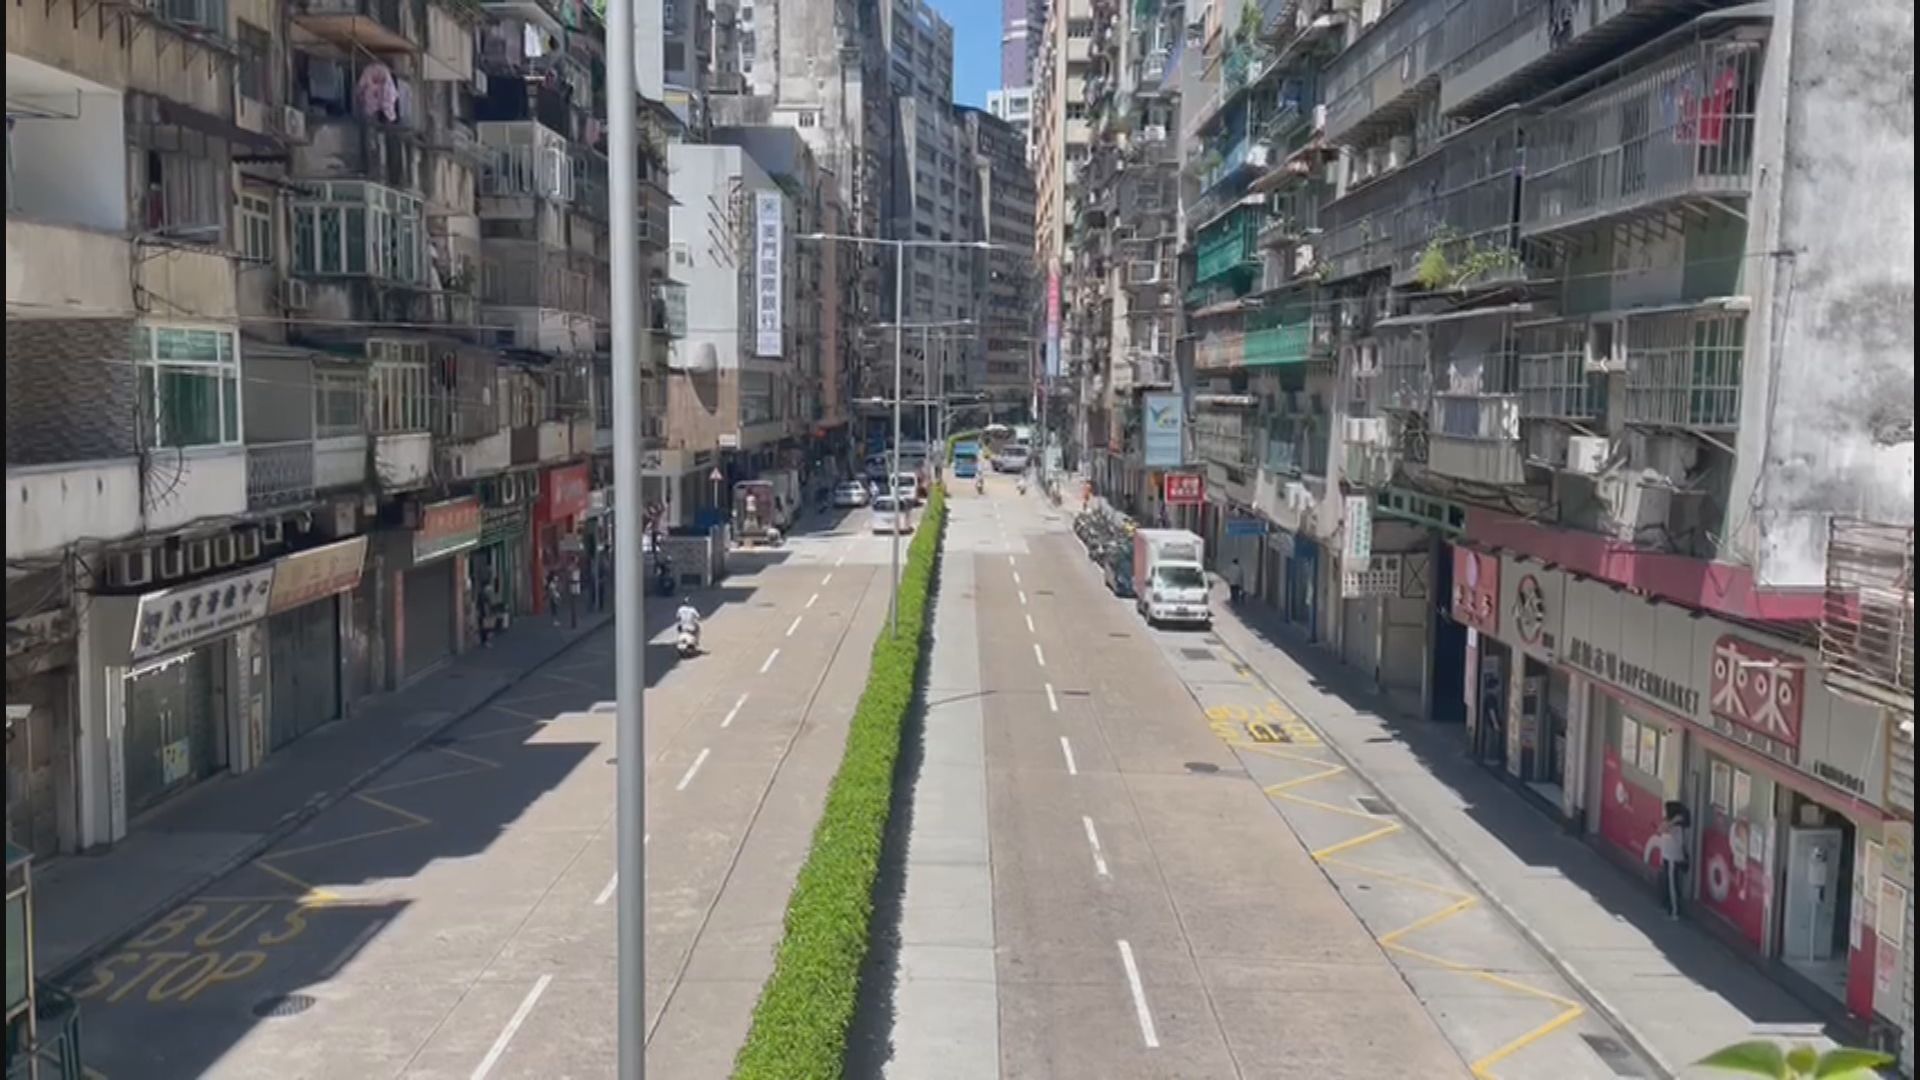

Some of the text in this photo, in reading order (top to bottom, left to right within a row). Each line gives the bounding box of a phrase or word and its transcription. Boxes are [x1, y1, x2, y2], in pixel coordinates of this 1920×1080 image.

[1619, 660, 1700, 716] SUPERMARKET
[125, 902, 311, 949] BUS
[73, 949, 267, 1003] STOP
